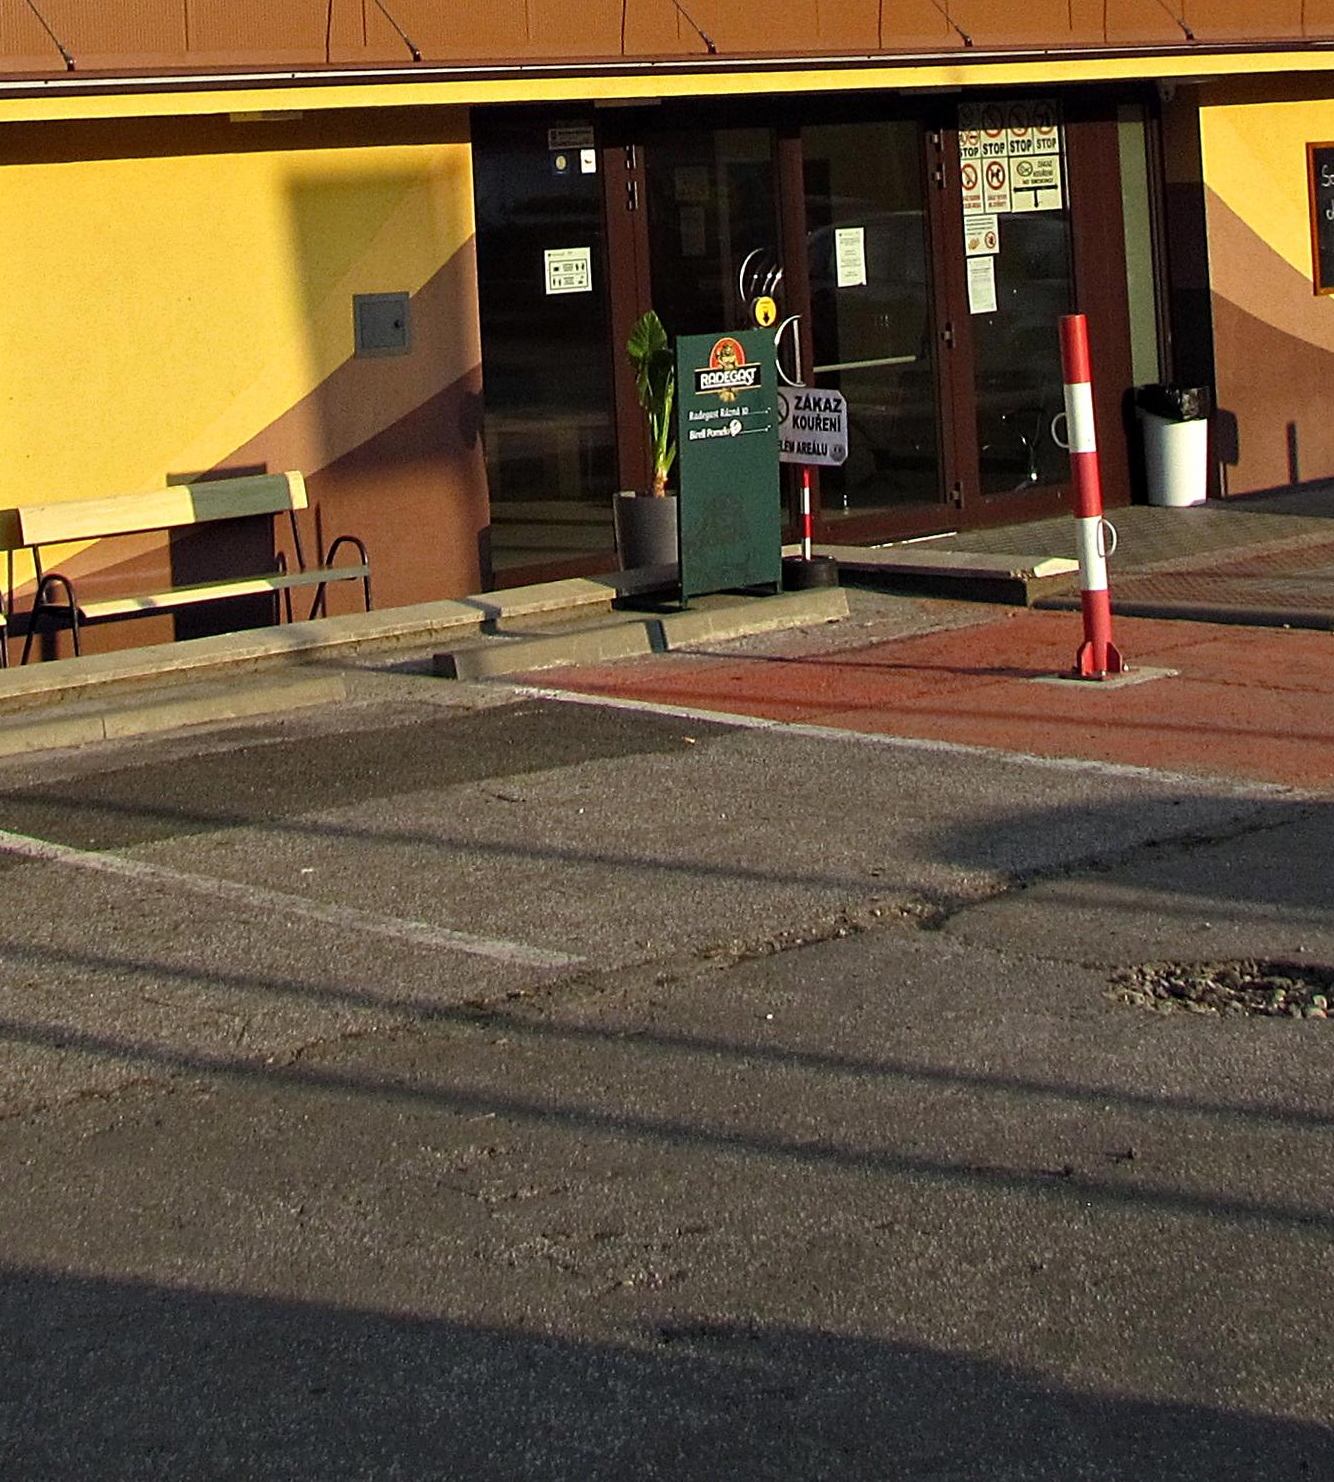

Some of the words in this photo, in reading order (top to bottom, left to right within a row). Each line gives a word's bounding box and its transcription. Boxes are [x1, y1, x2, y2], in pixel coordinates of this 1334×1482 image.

[983, 142, 1005, 155] STOP
[1009, 139, 1032, 153] STOP
[1036, 137, 1057, 149] STOP
[700, 368, 757, 390] RADEGAST
[794, 393, 842, 413] ZÁKAZ
[792, 413, 841, 432] KOUŘENÍ
[796, 439, 828, 456] AREÁLU
